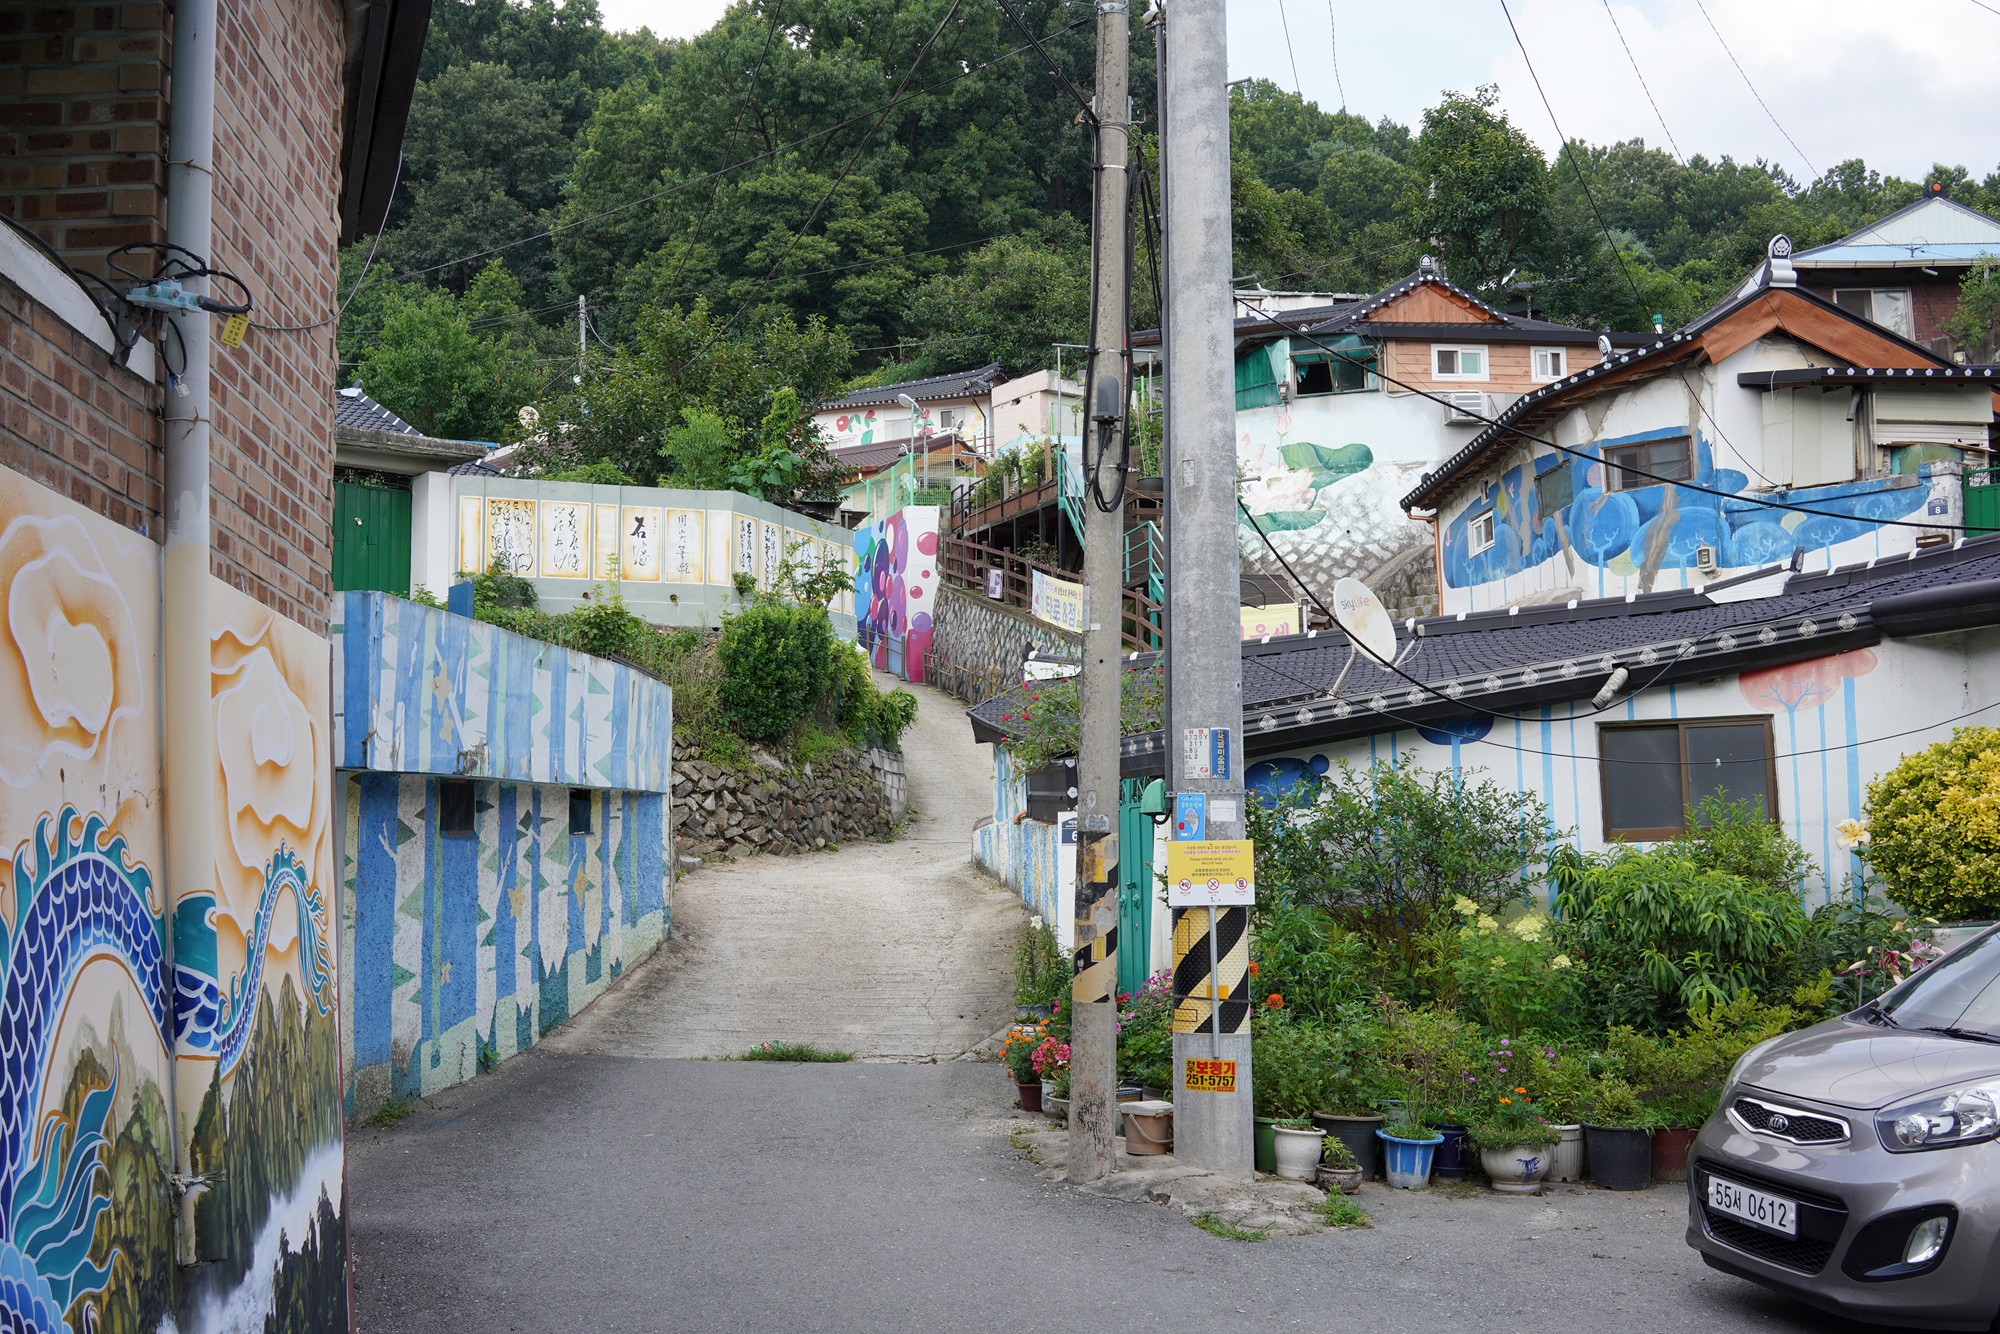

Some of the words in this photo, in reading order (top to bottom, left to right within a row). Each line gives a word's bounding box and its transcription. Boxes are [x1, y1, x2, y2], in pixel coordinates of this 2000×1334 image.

[1935, 506, 1941, 514] 8
[1045, 595, 1061, 622] 타로
[1195, 1060, 1236, 1076] 보청기
[1769, 1115, 1784, 1129] KIA
[1715, 1182, 1742, 1212] 55서
[1748, 1193, 1788, 1228] 0612
